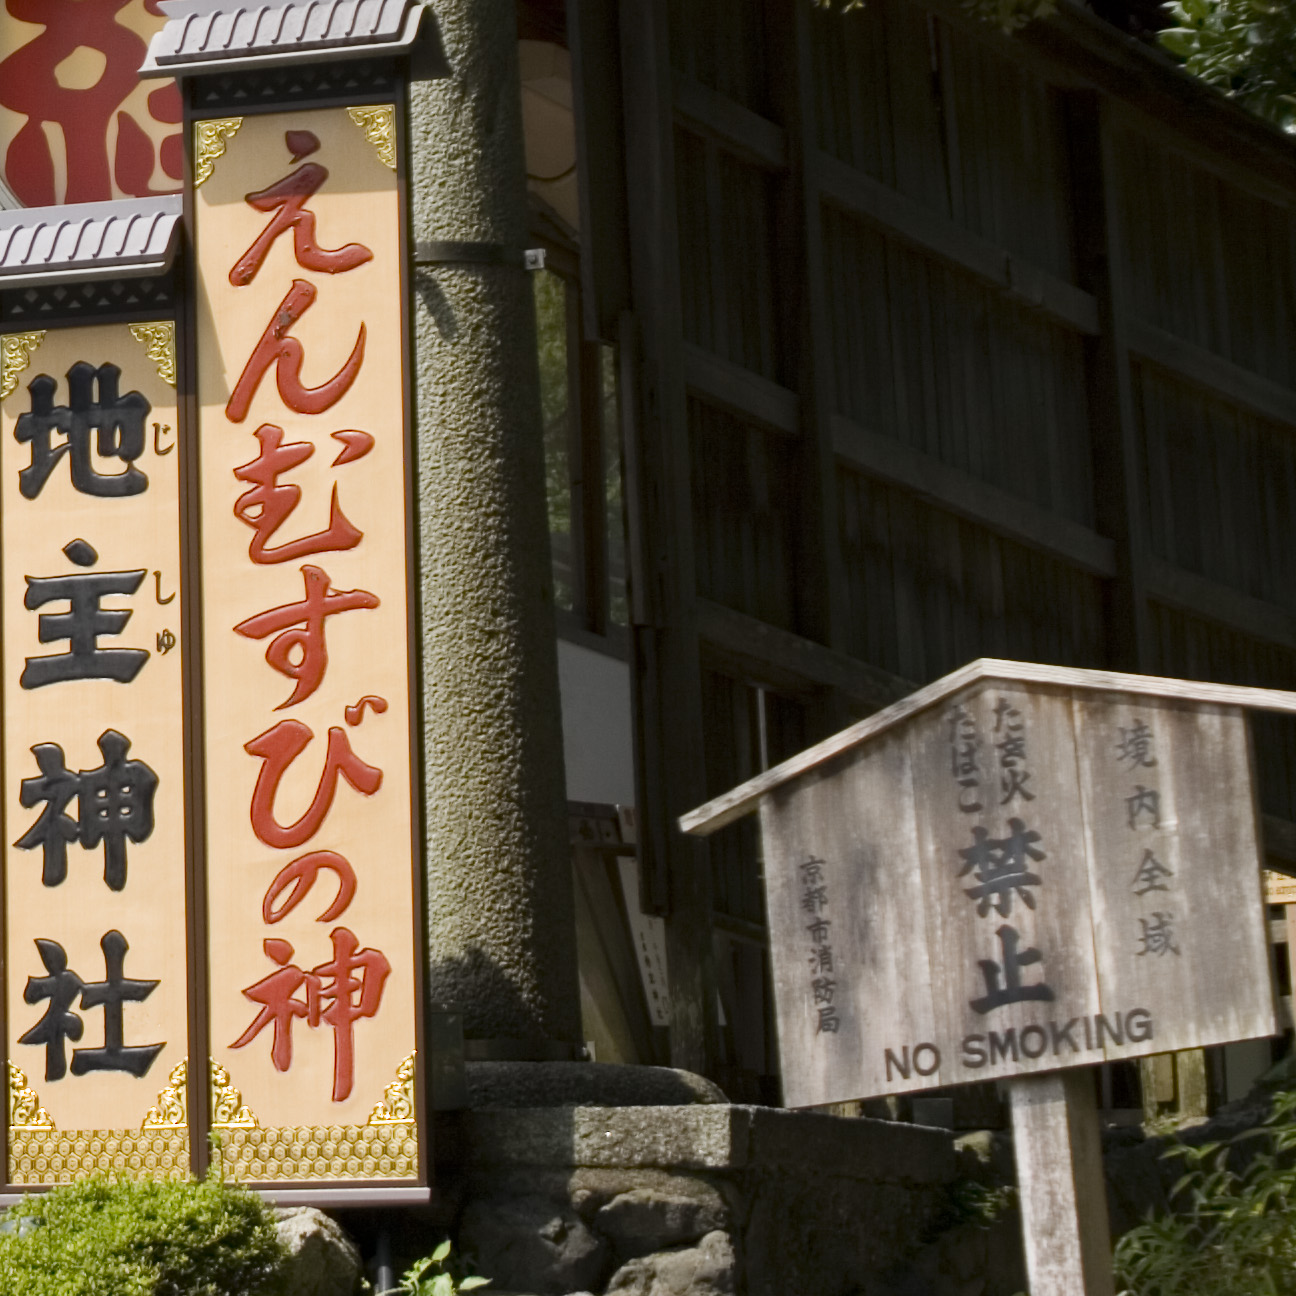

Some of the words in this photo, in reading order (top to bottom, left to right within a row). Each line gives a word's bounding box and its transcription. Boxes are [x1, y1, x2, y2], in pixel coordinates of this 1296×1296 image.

[152, 422, 175, 457] じ
[226, 130, 393, 1103] えんむすびの神
[13, 362, 167, 1082] 地主神社
[992, 696, 1036, 806] たき火
[957, 817, 1056, 1015] 禁止
[1114, 717, 1183, 959] 境内全域
[799, 855, 842, 1036] 京都市消防局
[884, 1041, 943, 1082] NO
[962, 1007, 1155, 1069] SMOKING
